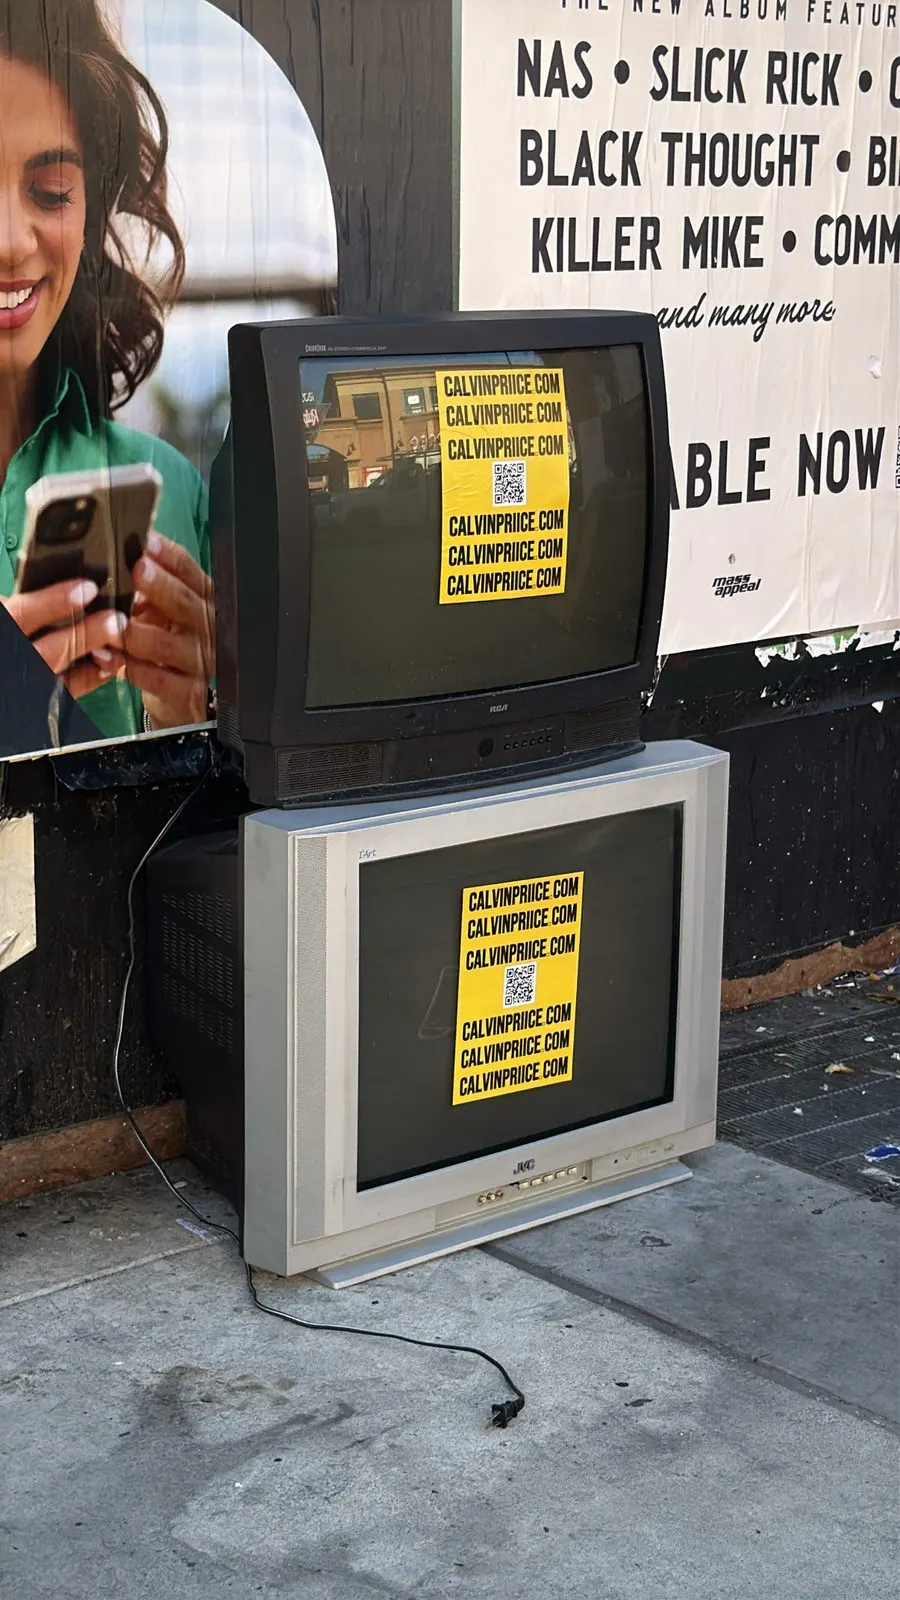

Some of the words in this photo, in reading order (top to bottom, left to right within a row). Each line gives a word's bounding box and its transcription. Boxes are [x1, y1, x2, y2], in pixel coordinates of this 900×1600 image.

[633, 0, 681, 15] NEW
[705, 0, 787, 21] ALBUM
[807, 0, 897, 27] FEATUR
[517, 38, 593, 99] NAS
[649, 44, 749, 104] SLICK
[766, 50, 842, 106] RICK
[520, 129, 643, 187] BLACK
[661, 132, 820, 187] THOUGHT
[867, 136, 900, 187] BI
[532, 217, 662, 273] KILLER
[683, 216, 764, 270] MIKE
[814, 214, 900, 266] COMM
[656, 292, 706, 329] and
[708, 301, 775, 342] many
[775, 299, 835, 324] more
[797, 426, 886, 498] NOW
[712, 574, 751, 587] mass
[714, 578, 762, 598] appeal
[489, 704, 508, 713] RCA
[513, 1158, 535, 1175] JVC
